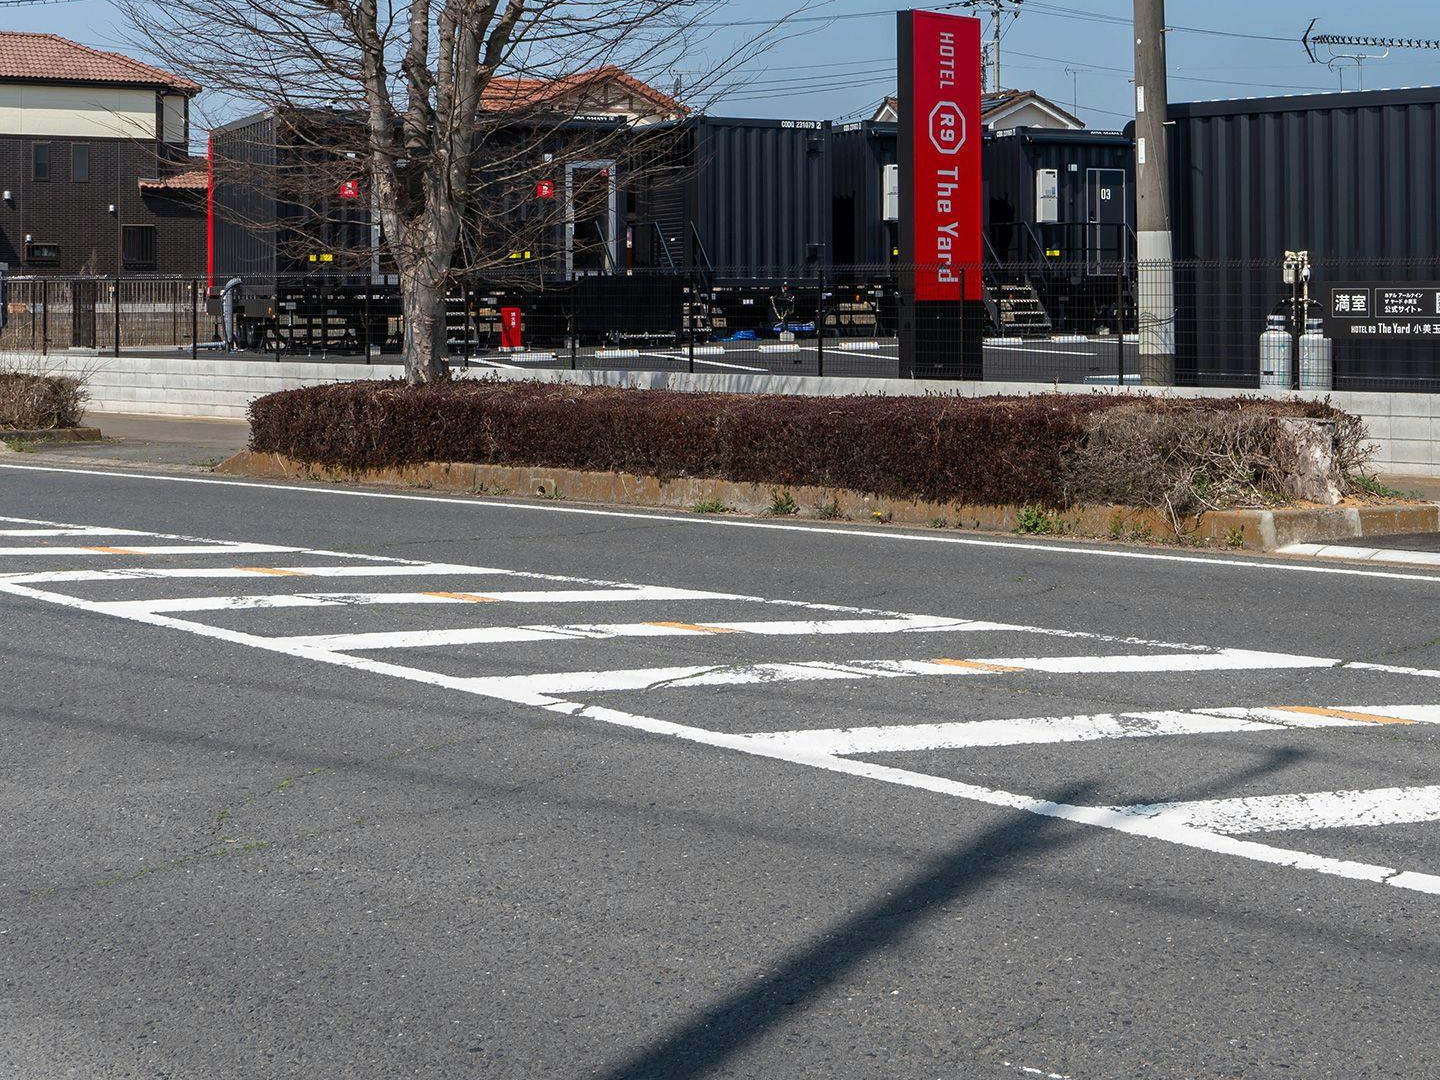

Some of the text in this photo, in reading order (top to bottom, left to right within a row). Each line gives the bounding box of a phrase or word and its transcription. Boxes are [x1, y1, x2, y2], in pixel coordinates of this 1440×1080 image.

[937, 31, 959, 283] HOTEL R9 The Yard
[1101, 188, 1111, 200] 03
[1335, 295, 1367, 312] 満室
[1378, 323, 1391, 334] The
[1392, 323, 1411, 334] Yard
